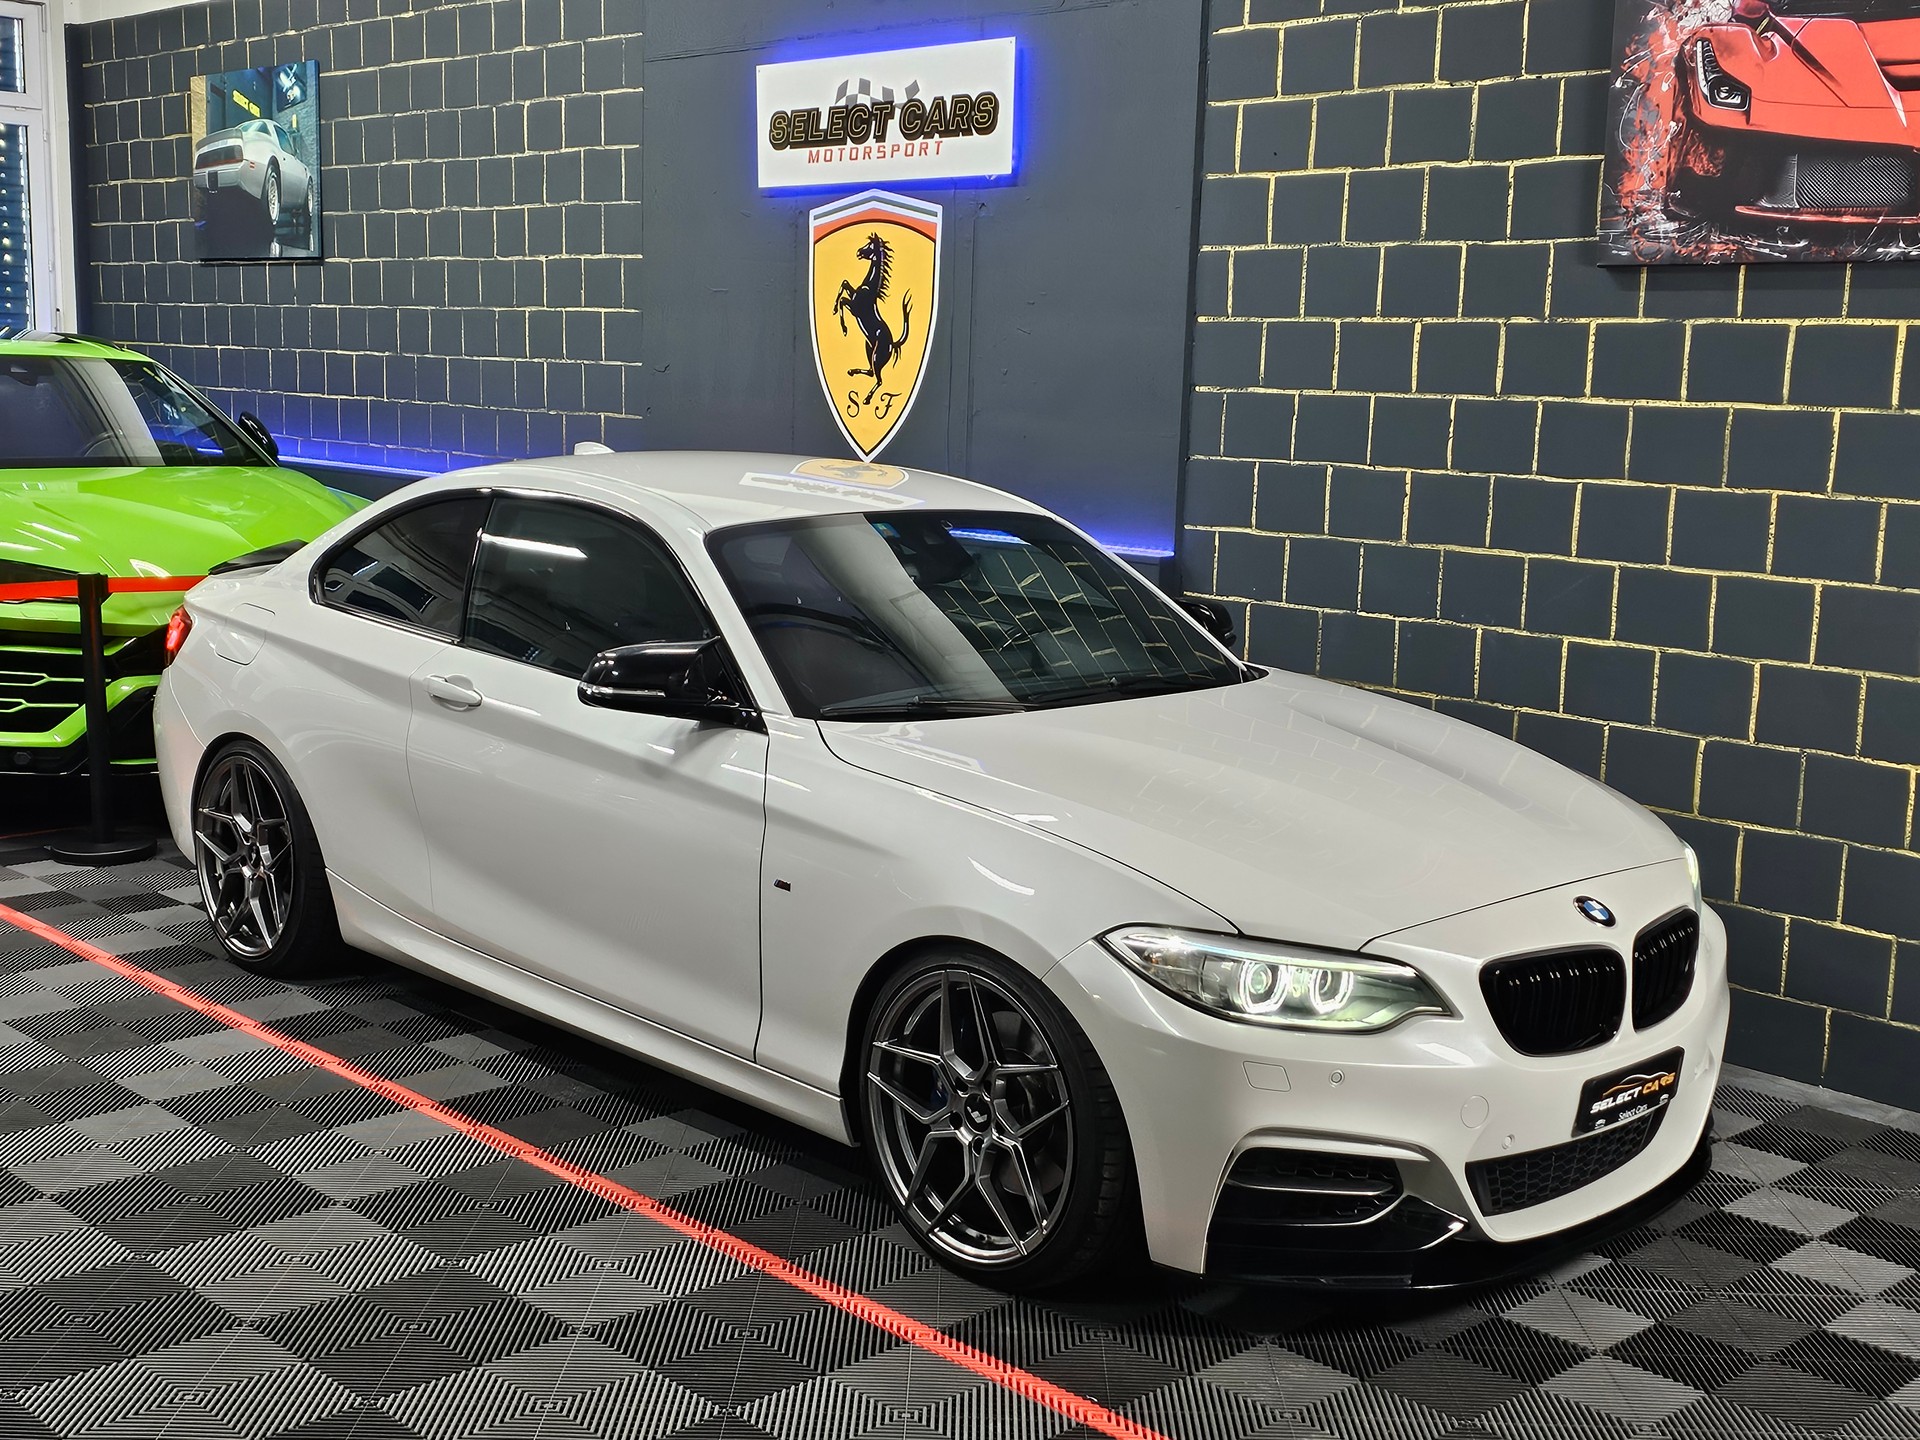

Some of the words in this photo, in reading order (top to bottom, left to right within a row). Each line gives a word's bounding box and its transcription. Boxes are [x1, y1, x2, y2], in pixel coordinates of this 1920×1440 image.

[769, 101, 895, 150] SELECT
[900, 91, 999, 140] CARS
[807, 140, 943, 164] MOTORSPORT
[847, 390, 860, 418] S
[875, 392, 902, 419] F
[1590, 1086, 1642, 1114] SELECT
[1642, 1072, 1676, 1094] CARS
